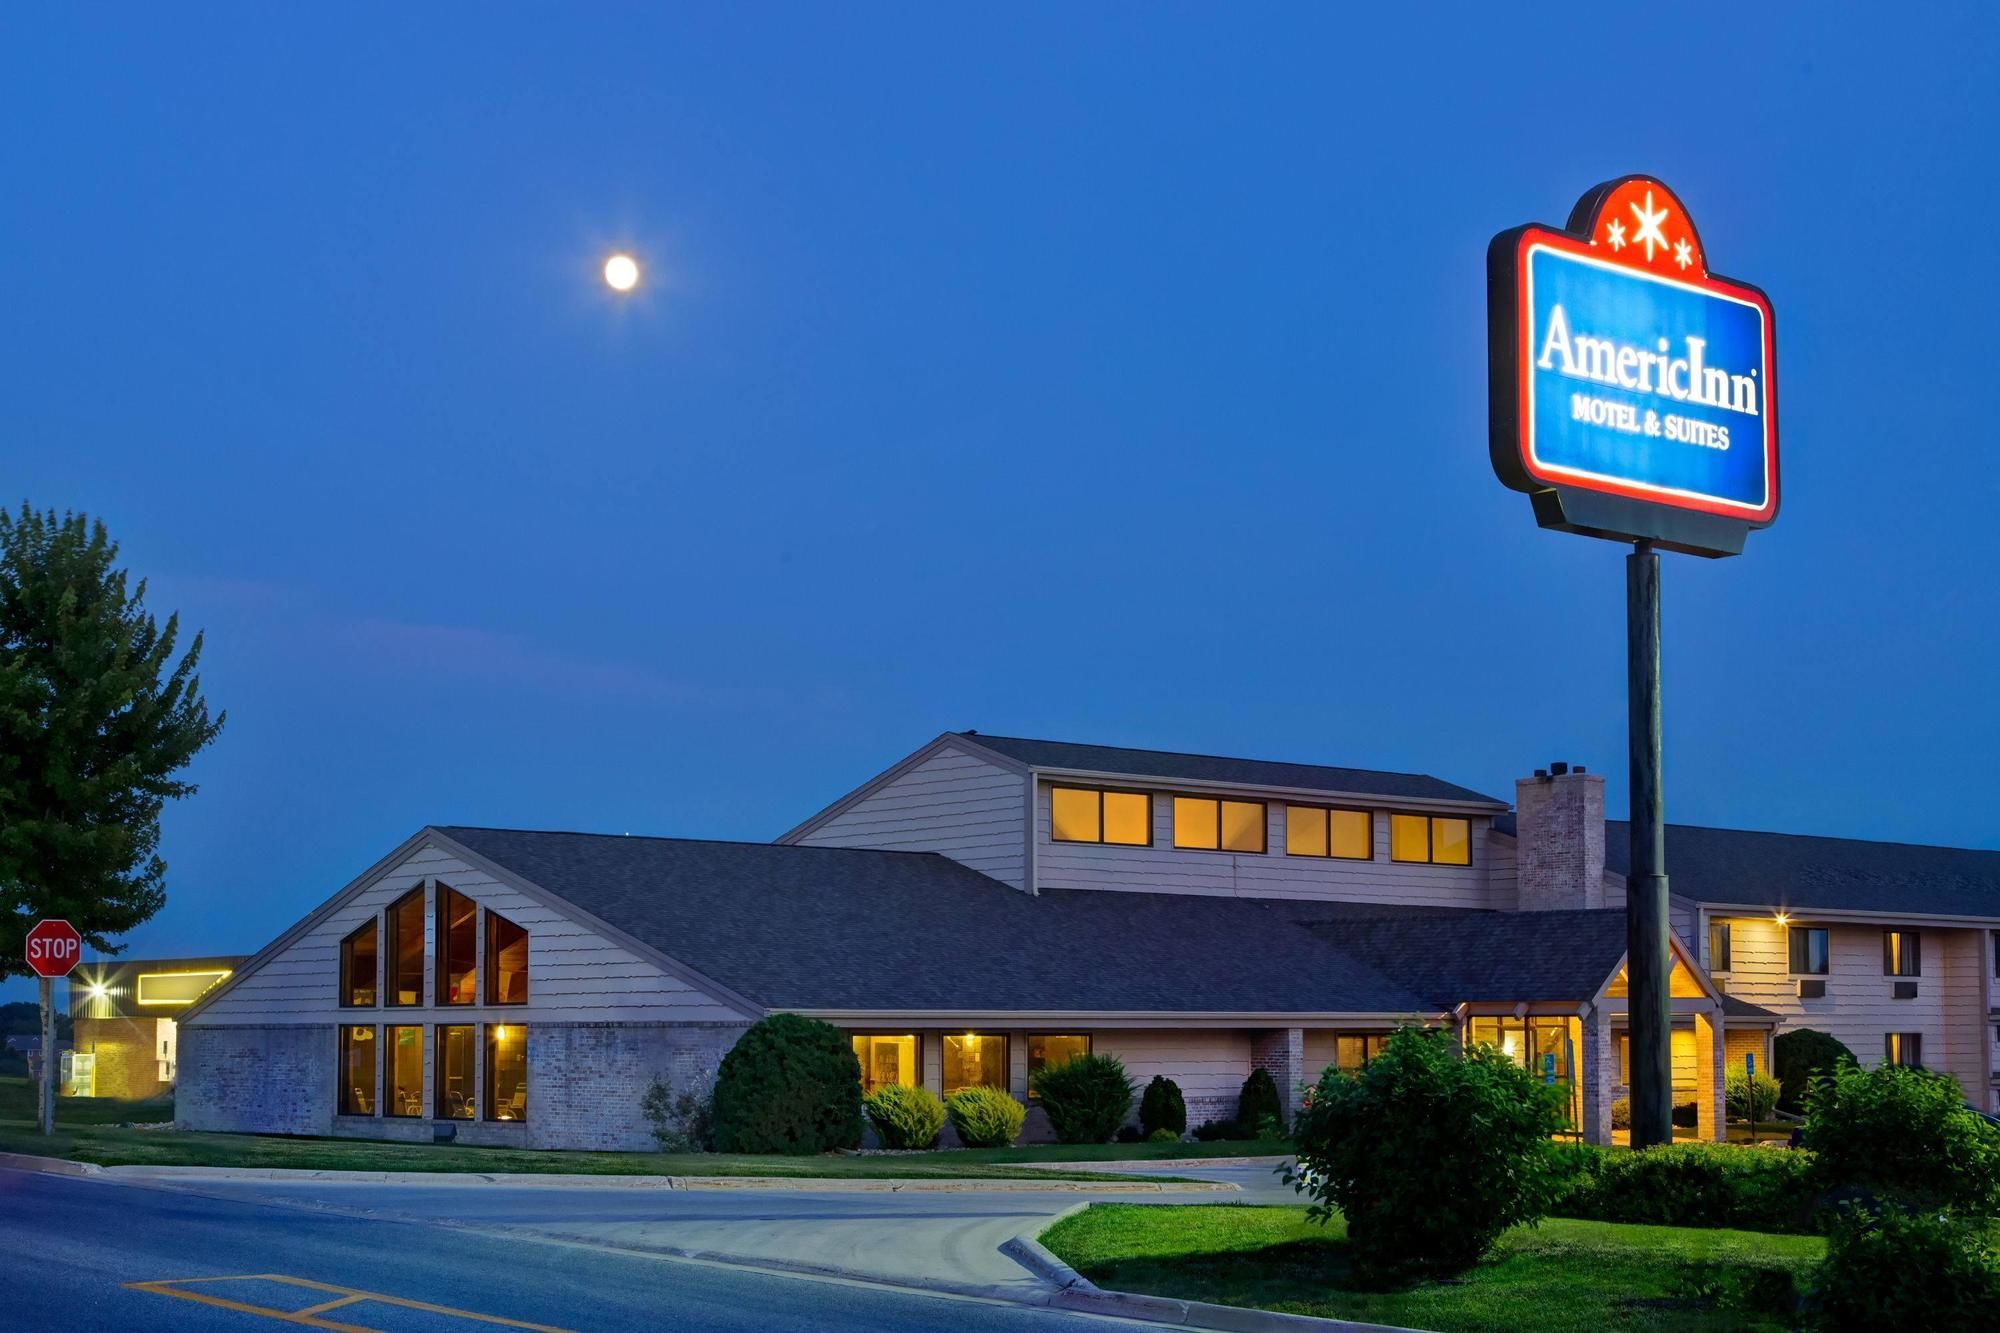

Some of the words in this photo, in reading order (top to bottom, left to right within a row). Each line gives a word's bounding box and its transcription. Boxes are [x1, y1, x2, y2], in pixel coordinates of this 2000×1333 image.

[1537, 304, 1758, 416] AmericInn
[1572, 394, 1641, 433] MOTEL
[1644, 409, 1662, 437] &
[1664, 414, 1730, 450] SUITES
[30, 938, 78, 959] STOP
